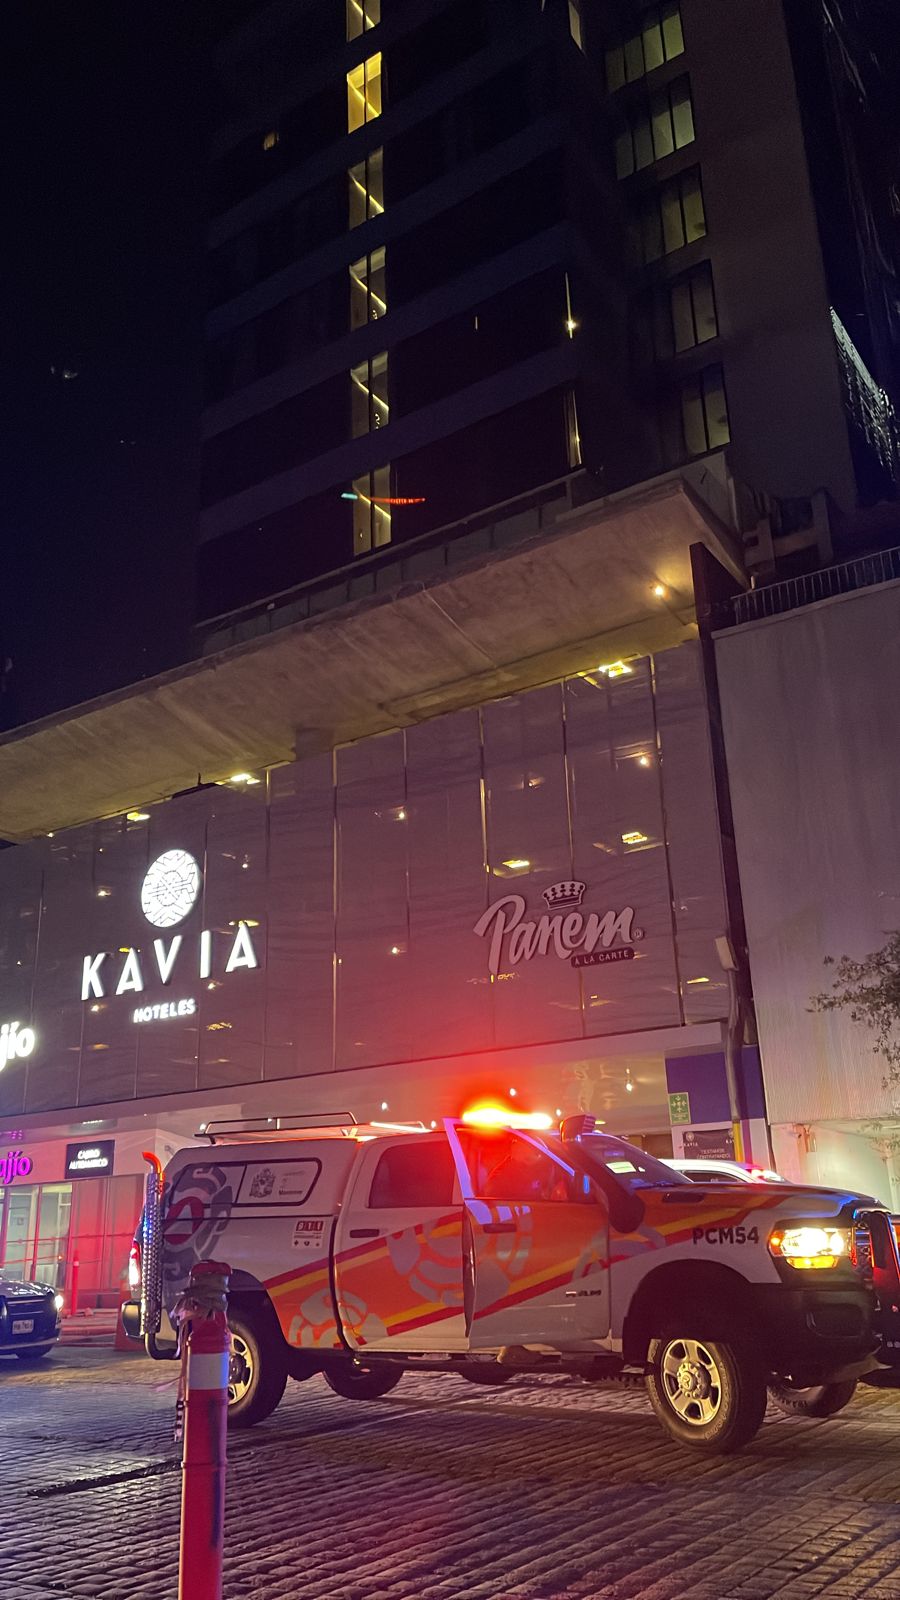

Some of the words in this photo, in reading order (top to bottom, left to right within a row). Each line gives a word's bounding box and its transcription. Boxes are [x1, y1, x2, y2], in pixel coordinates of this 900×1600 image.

[473, 894, 634, 975] Panem
[81, 921, 258, 1001] KAVIA
[584, 954, 595, 965] LA
[599, 949, 629, 962] CARTE
[133, 998, 197, 1023] HOTELES
[693, 1226, 760, 1245] PCM54
